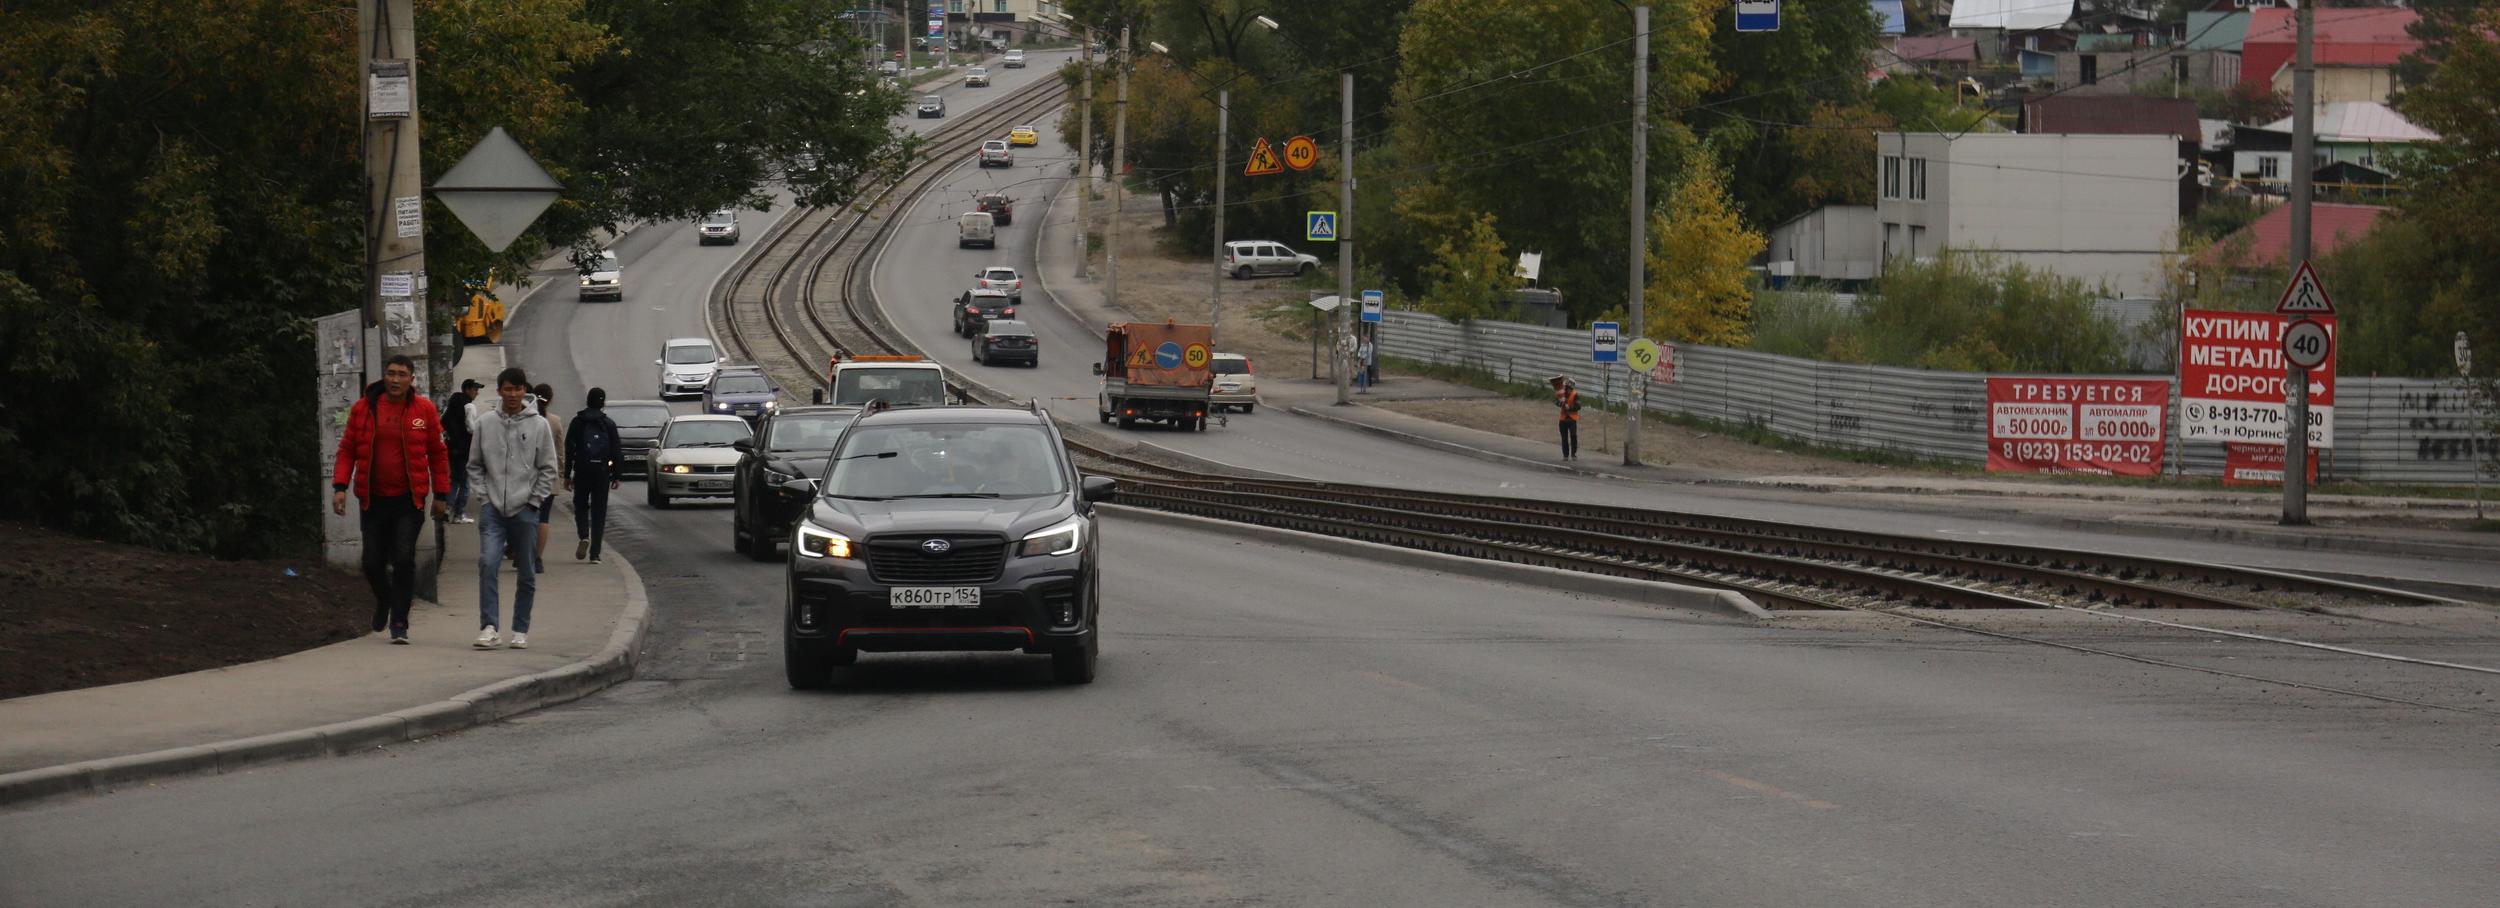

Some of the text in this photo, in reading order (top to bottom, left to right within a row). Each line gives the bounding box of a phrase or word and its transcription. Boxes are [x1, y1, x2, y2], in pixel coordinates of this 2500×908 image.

[1291, 146, 1309, 160] 40
[2186, 317, 2270, 342] КУПИМ
[2293, 334, 2320, 356] 40
[1188, 350, 1204, 362] 50
[1634, 348, 1652, 365] 40
[2012, 384, 2142, 402] ТРЕБУЕТСЯ
[1996, 406, 2068, 417] АВТОМЕХАНИК
[2089, 408, 2148, 418] АВТОМАЛЯР
[2009, 418, 2028, 435] 50
[2097, 420, 2117, 437] 60
[2190, 426, 2208, 436] ул.
[2212, 425, 2231, 436] 1-я
[2002, 442, 2151, 463] 8 (923) 153-02-02
[954, 588, 978, 600] 154
